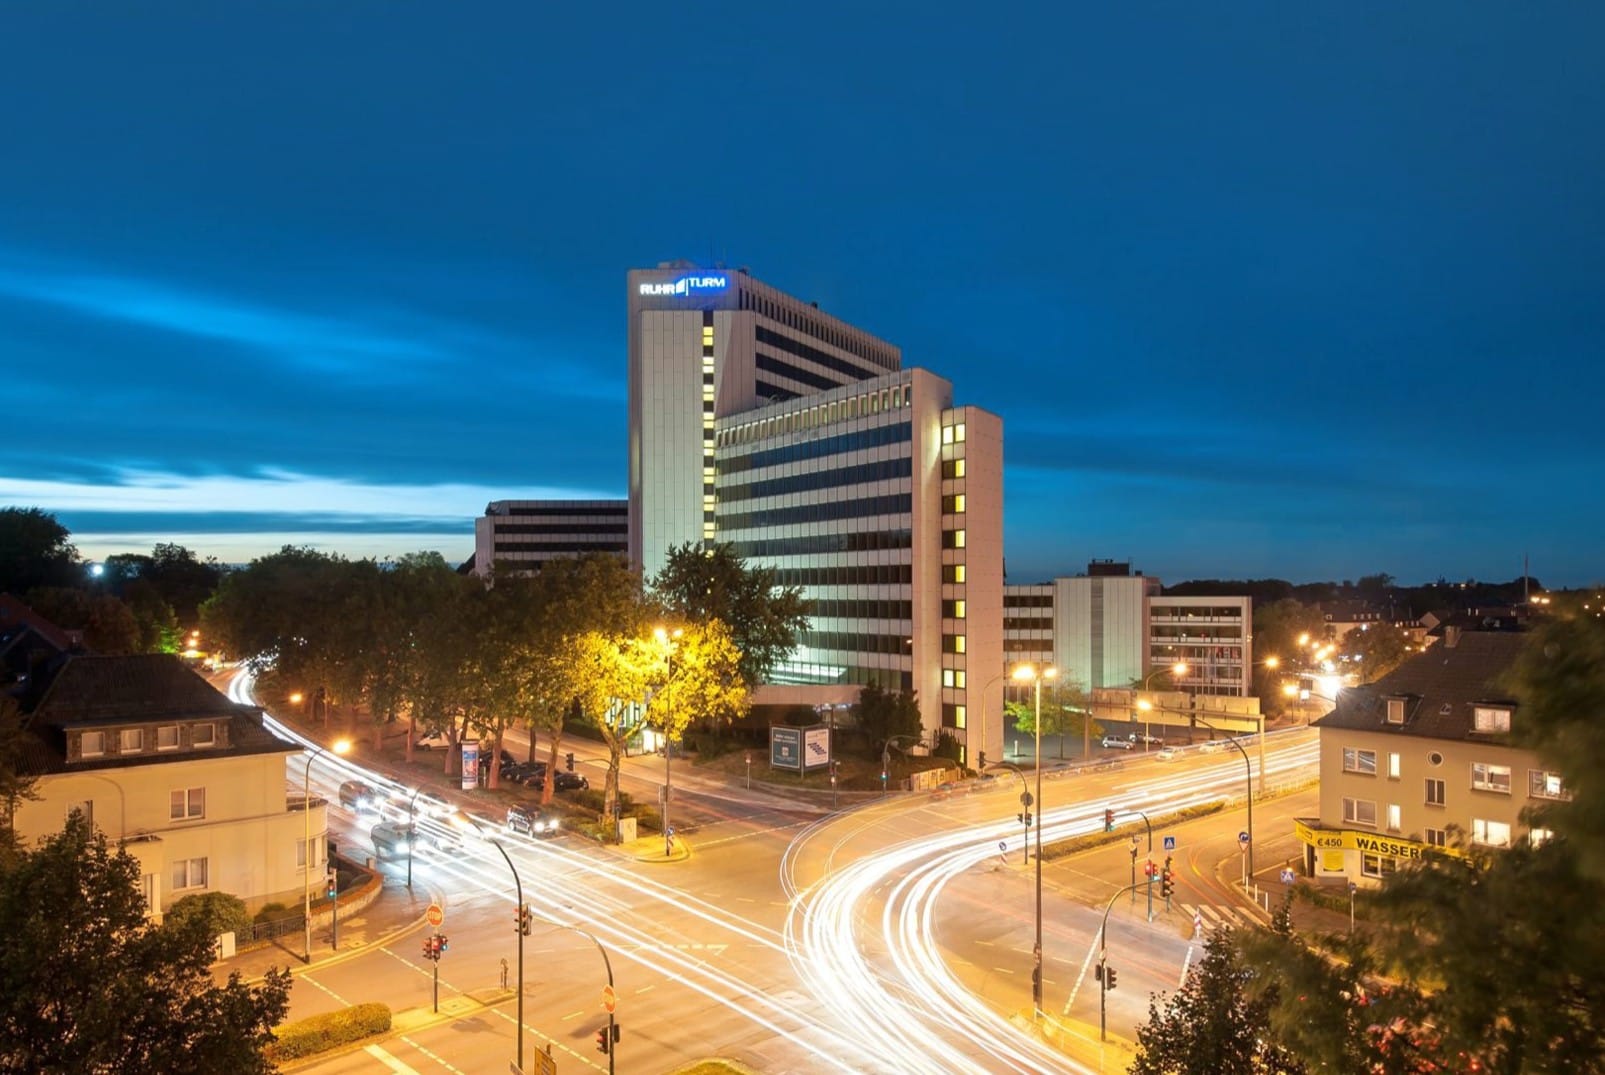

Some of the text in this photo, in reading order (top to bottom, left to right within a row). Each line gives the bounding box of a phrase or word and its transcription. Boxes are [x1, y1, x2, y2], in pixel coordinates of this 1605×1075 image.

[639, 277, 725, 295] RUHR TURM
[1356, 837, 1423, 859] WASSER
